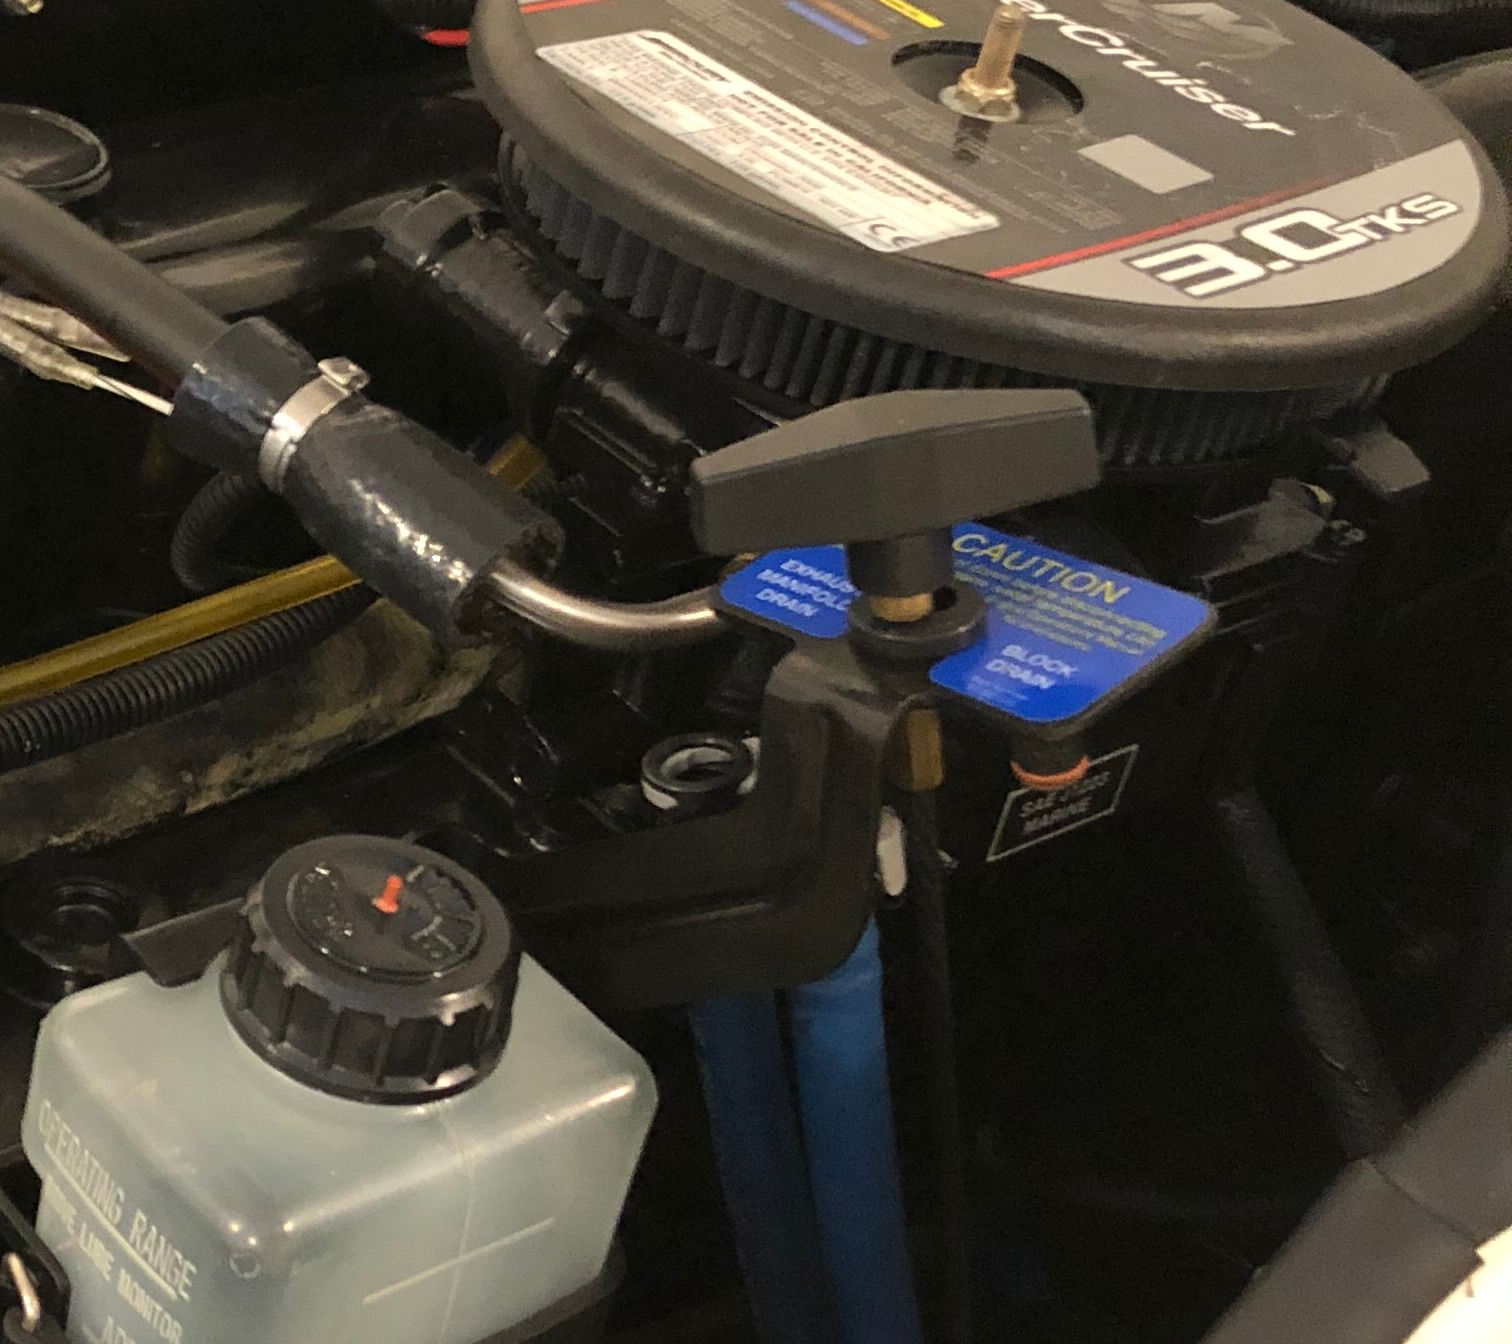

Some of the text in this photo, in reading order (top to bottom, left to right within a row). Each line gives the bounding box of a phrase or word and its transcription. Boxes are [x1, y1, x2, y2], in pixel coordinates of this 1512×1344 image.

[726, 93, 759, 109] NOT
[843, 157, 933, 206] CALIFORNIA
[806, 126, 876, 163] CONTROL
[951, 532, 1131, 604] CAUTION
[755, 587, 820, 617] DRAIN
[984, 658, 1056, 690] DRAIN
[1000, 643, 1079, 679] BLOCK
[38, 1100, 197, 1303] OPERATING RANGE
[79, 1223, 115, 1282] LUBE
